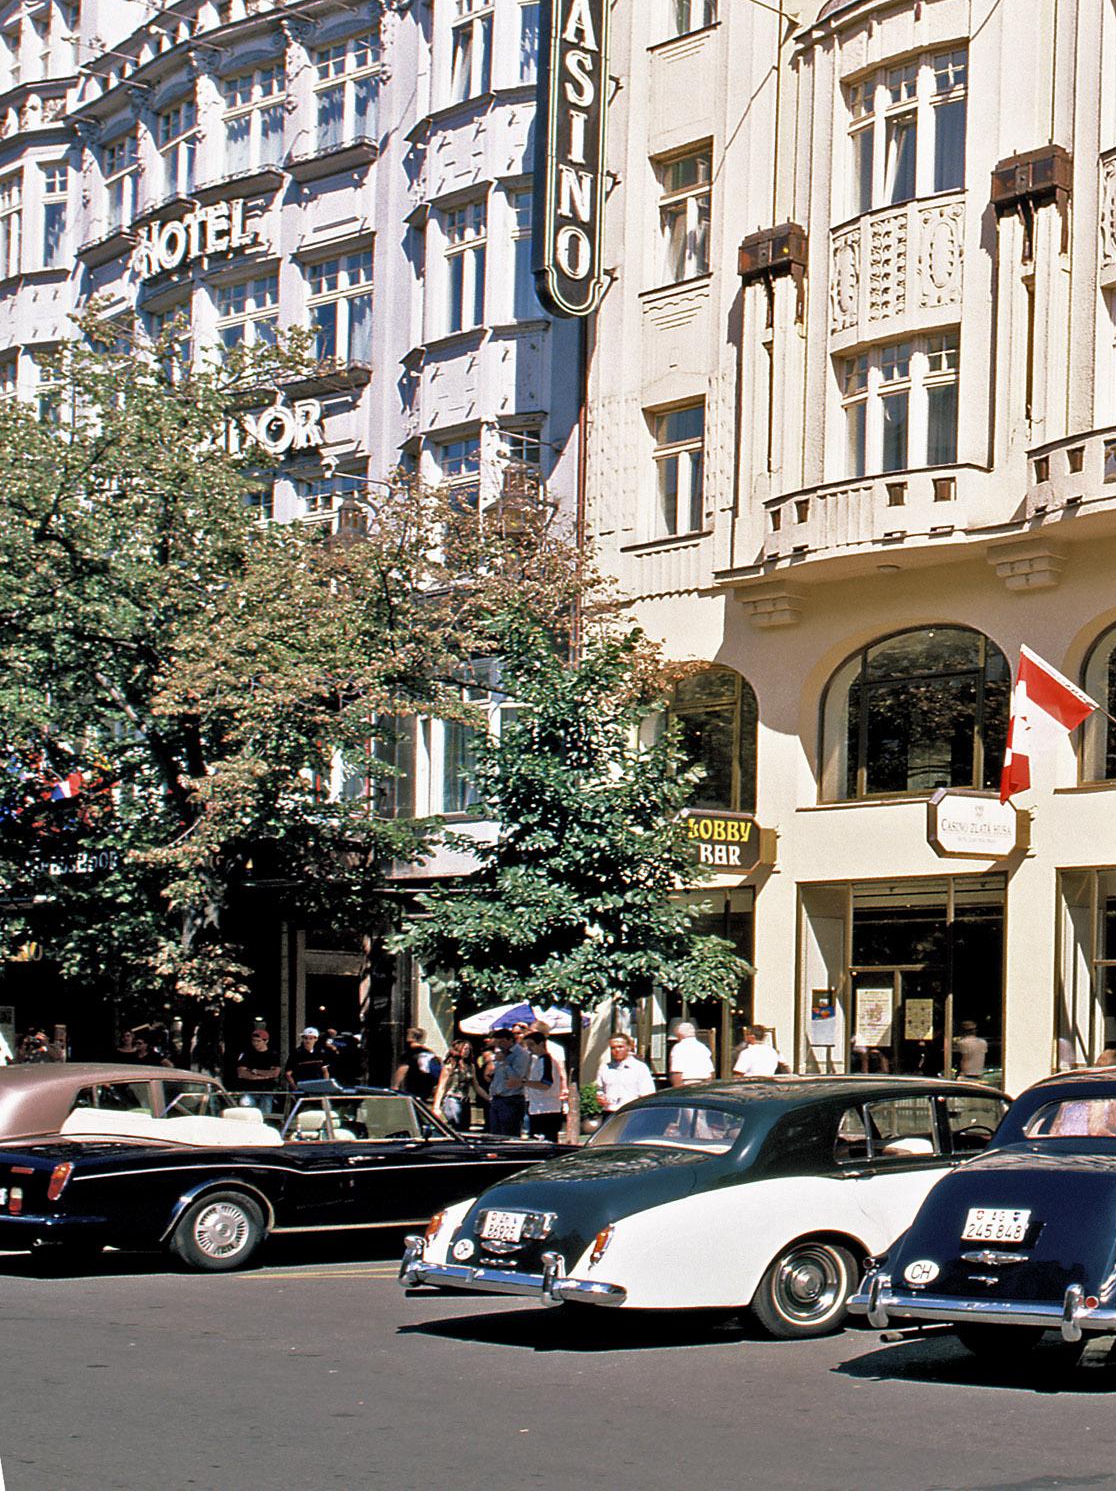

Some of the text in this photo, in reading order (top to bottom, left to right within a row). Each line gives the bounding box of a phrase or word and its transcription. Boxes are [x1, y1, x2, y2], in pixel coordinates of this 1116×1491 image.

[138, 198, 256, 276] HOTEL
[688, 818, 752, 842] LOBBY
[700, 843, 741, 865] BAR
[911, 1263, 932, 1280] CH
